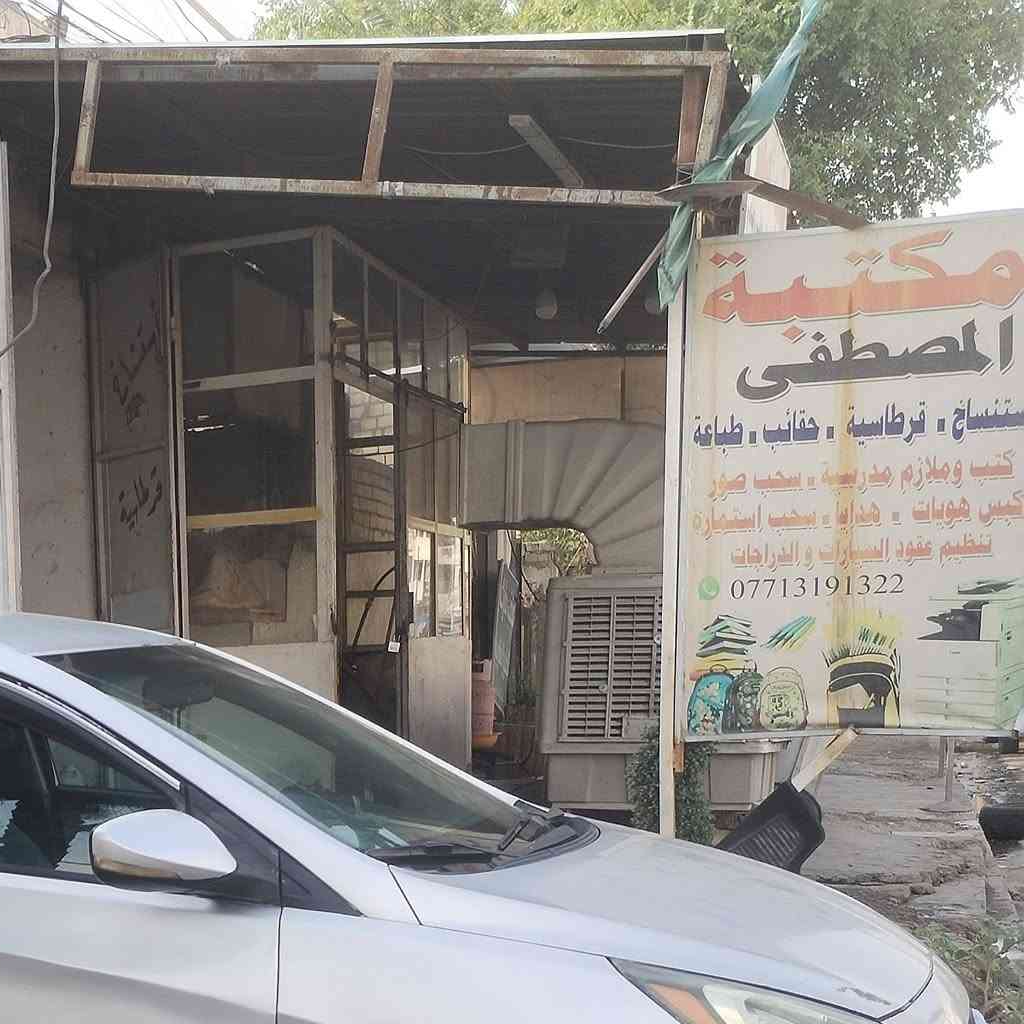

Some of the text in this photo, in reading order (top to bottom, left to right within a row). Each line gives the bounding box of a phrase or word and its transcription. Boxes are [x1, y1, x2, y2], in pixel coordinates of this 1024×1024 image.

[702, 228, 1024, 342] مكتبة
[736, 314, 1014, 402] المصطفى
[693, 397, 1024, 454] ستنساخ قرطاسية حقائب طباعة
[900, 456, 962, 494] وملازم
[969, 449, 1016, 486] كتب
[912, 496, 971, 530] هويات
[896, 536, 934, 566] عقود
[939, 533, 993, 568] تنظيم
[730, 573, 906, 601] 07713191322
